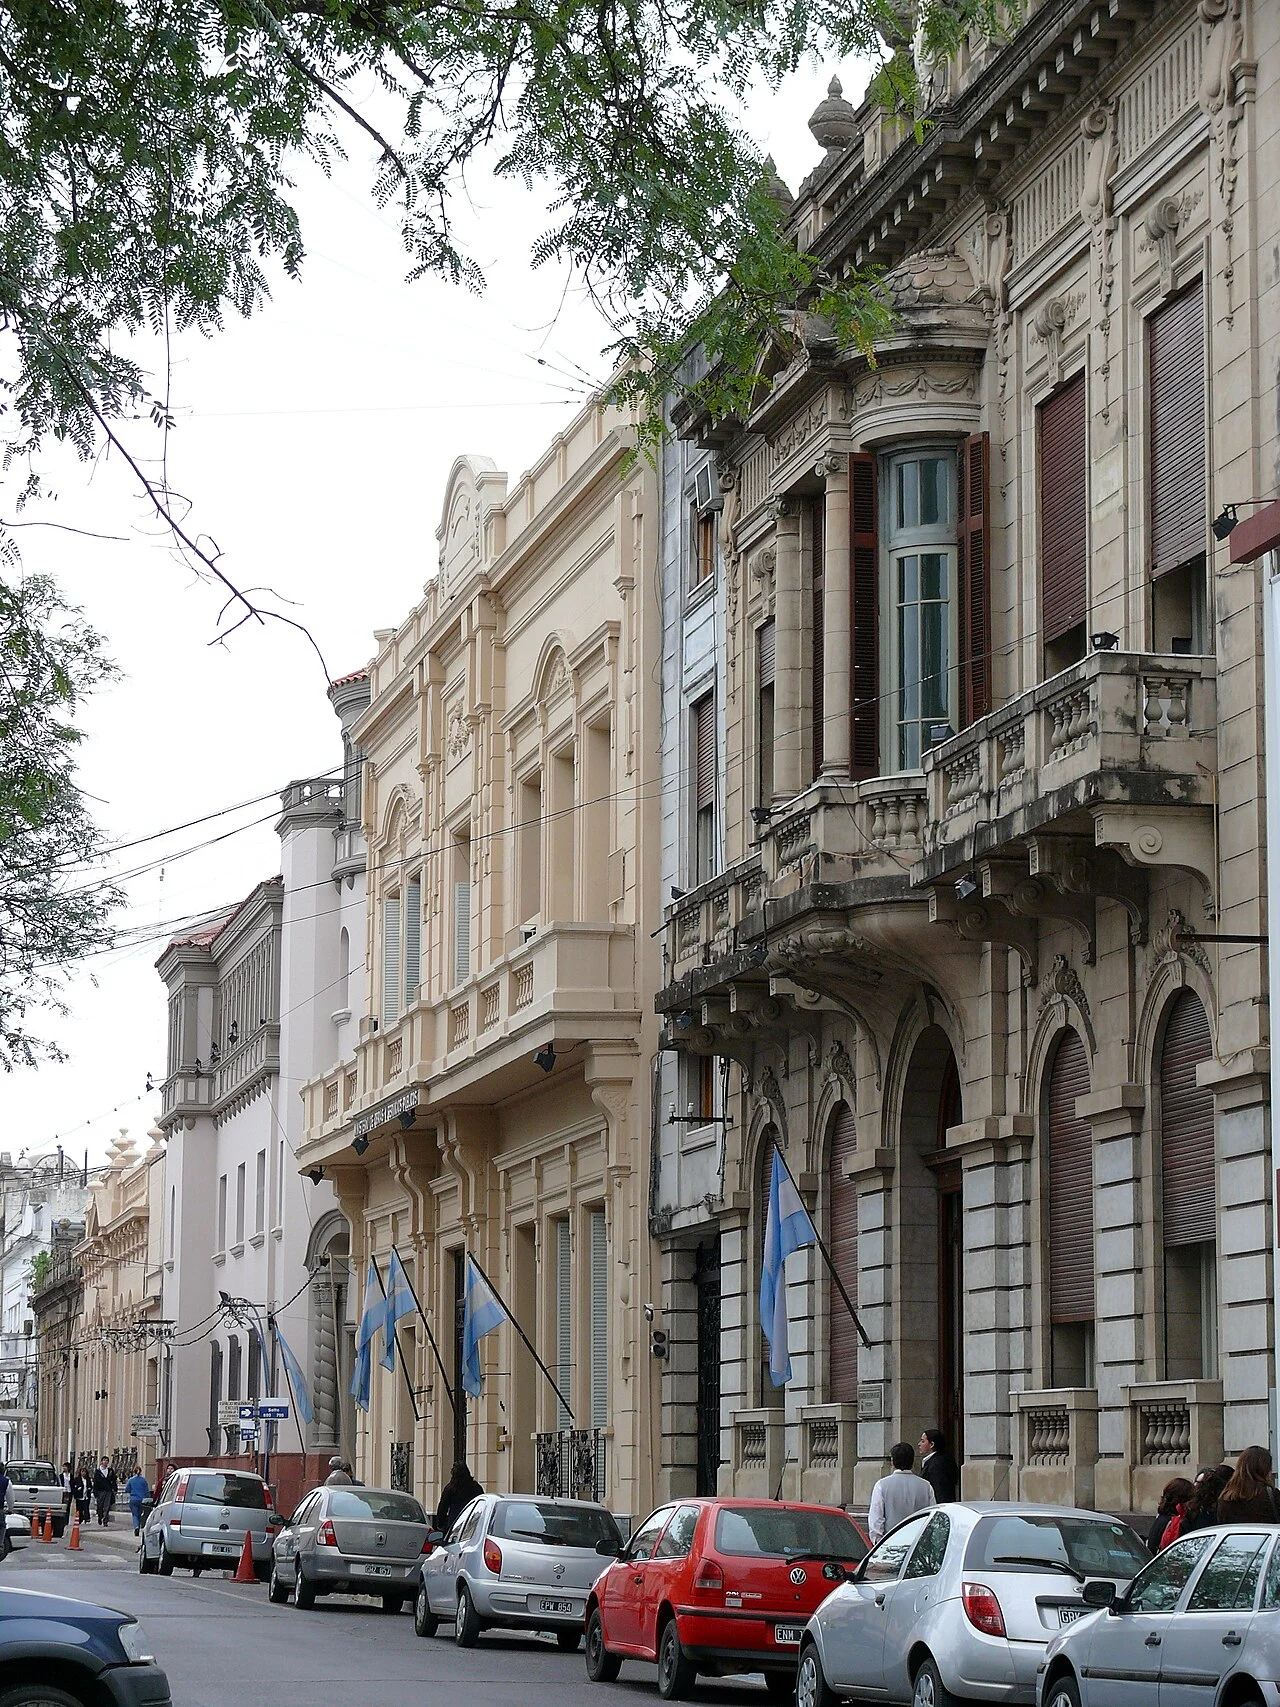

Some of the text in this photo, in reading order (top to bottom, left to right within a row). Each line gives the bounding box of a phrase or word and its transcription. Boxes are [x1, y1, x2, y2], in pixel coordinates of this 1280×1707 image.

[540, 1600, 571, 1612] EPW 854
[777, 1629, 794, 1640] ENM
